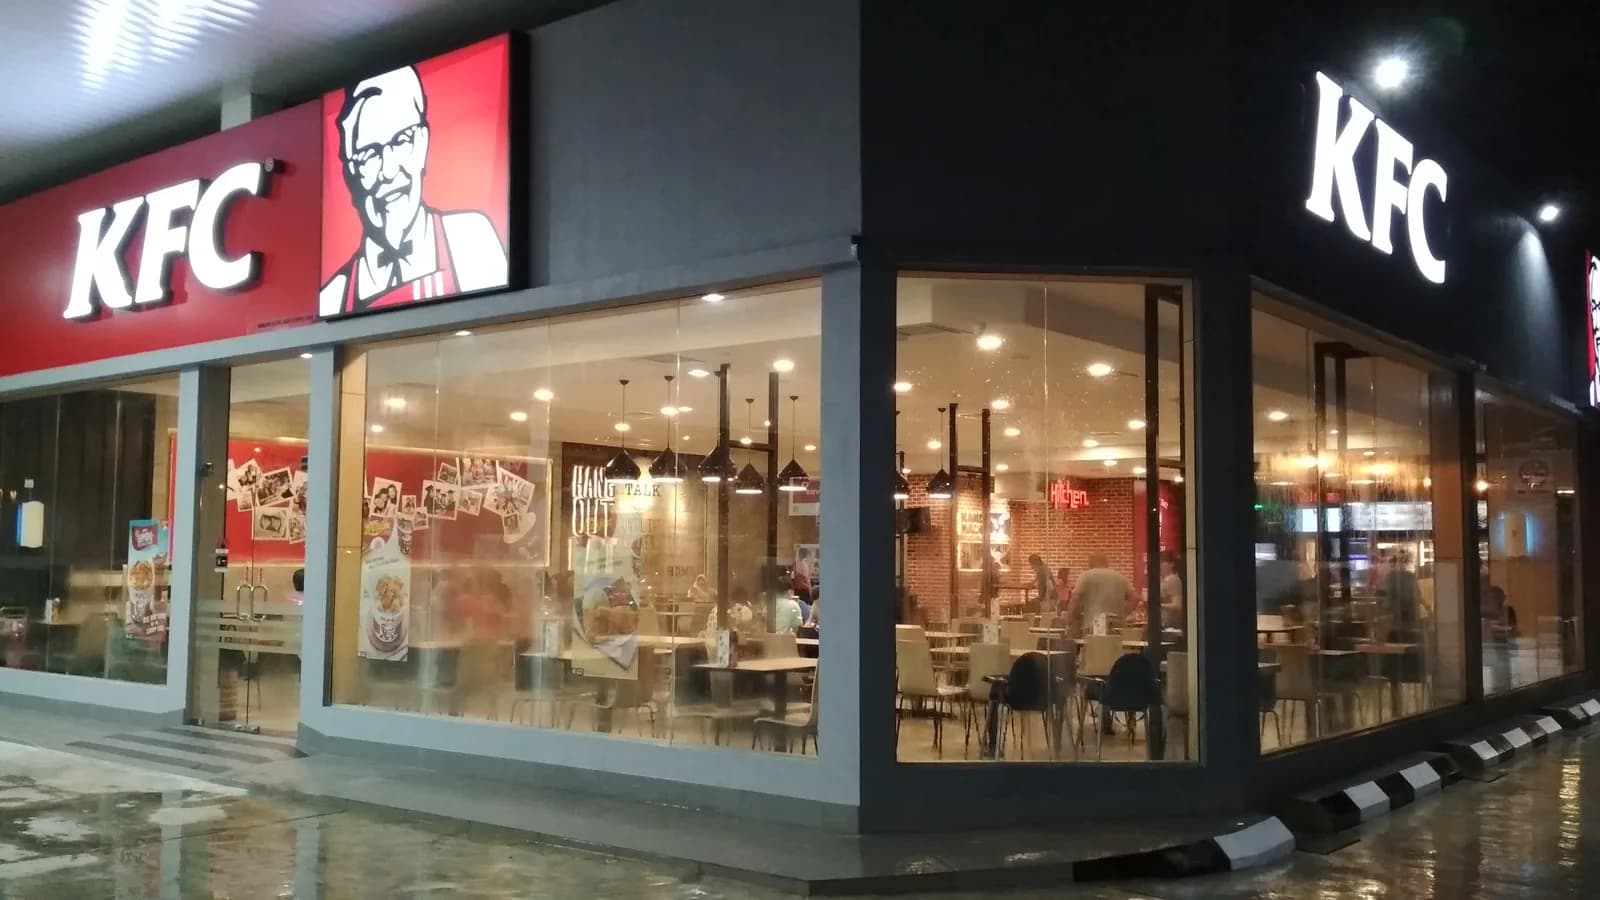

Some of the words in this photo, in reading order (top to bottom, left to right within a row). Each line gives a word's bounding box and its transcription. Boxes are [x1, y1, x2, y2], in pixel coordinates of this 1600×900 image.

[1305, 70, 1448, 284] KFC
[62, 161, 262, 320] KFC
[571, 464, 616, 499] HANG
[624, 482, 661, 497] TALK
[571, 497, 616, 538] OUT
